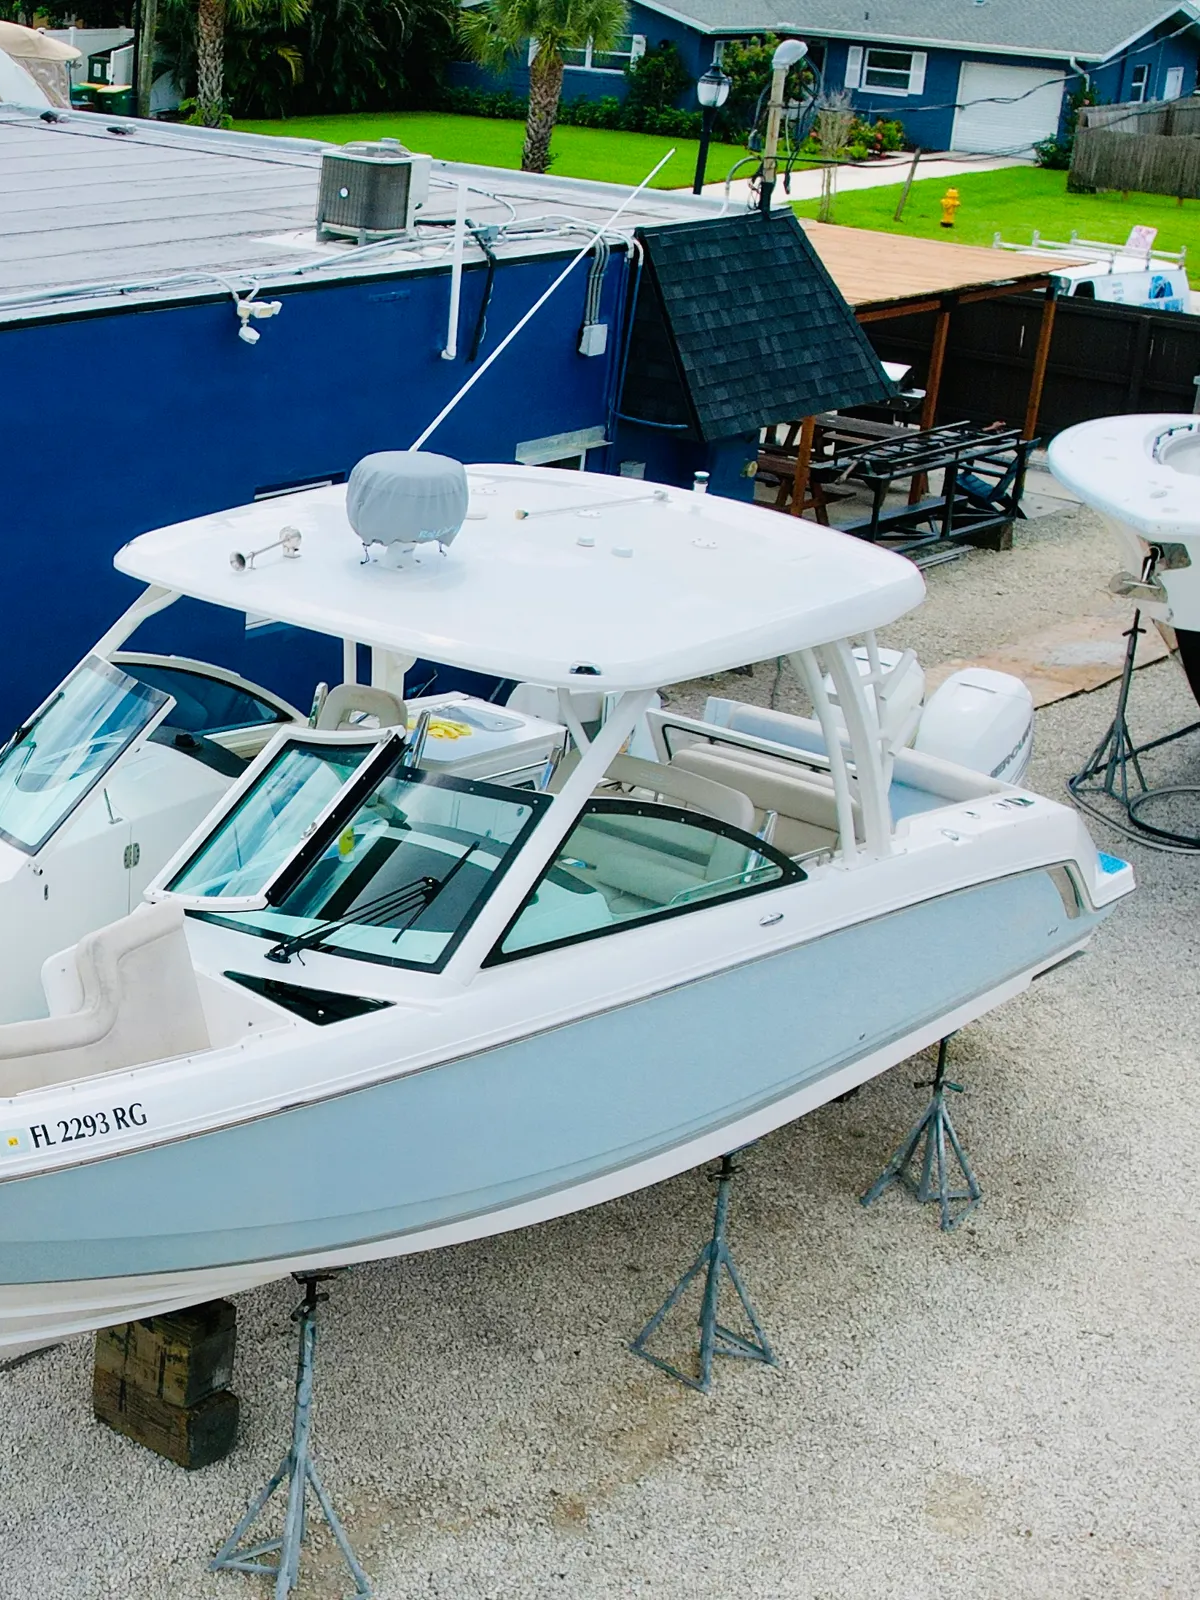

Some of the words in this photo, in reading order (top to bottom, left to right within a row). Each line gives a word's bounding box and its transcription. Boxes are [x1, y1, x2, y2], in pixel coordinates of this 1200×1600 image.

[29, 1123, 57, 1149] FL
[57, 1112, 110, 1143] 2293
[112, 1102, 148, 1130] RG
